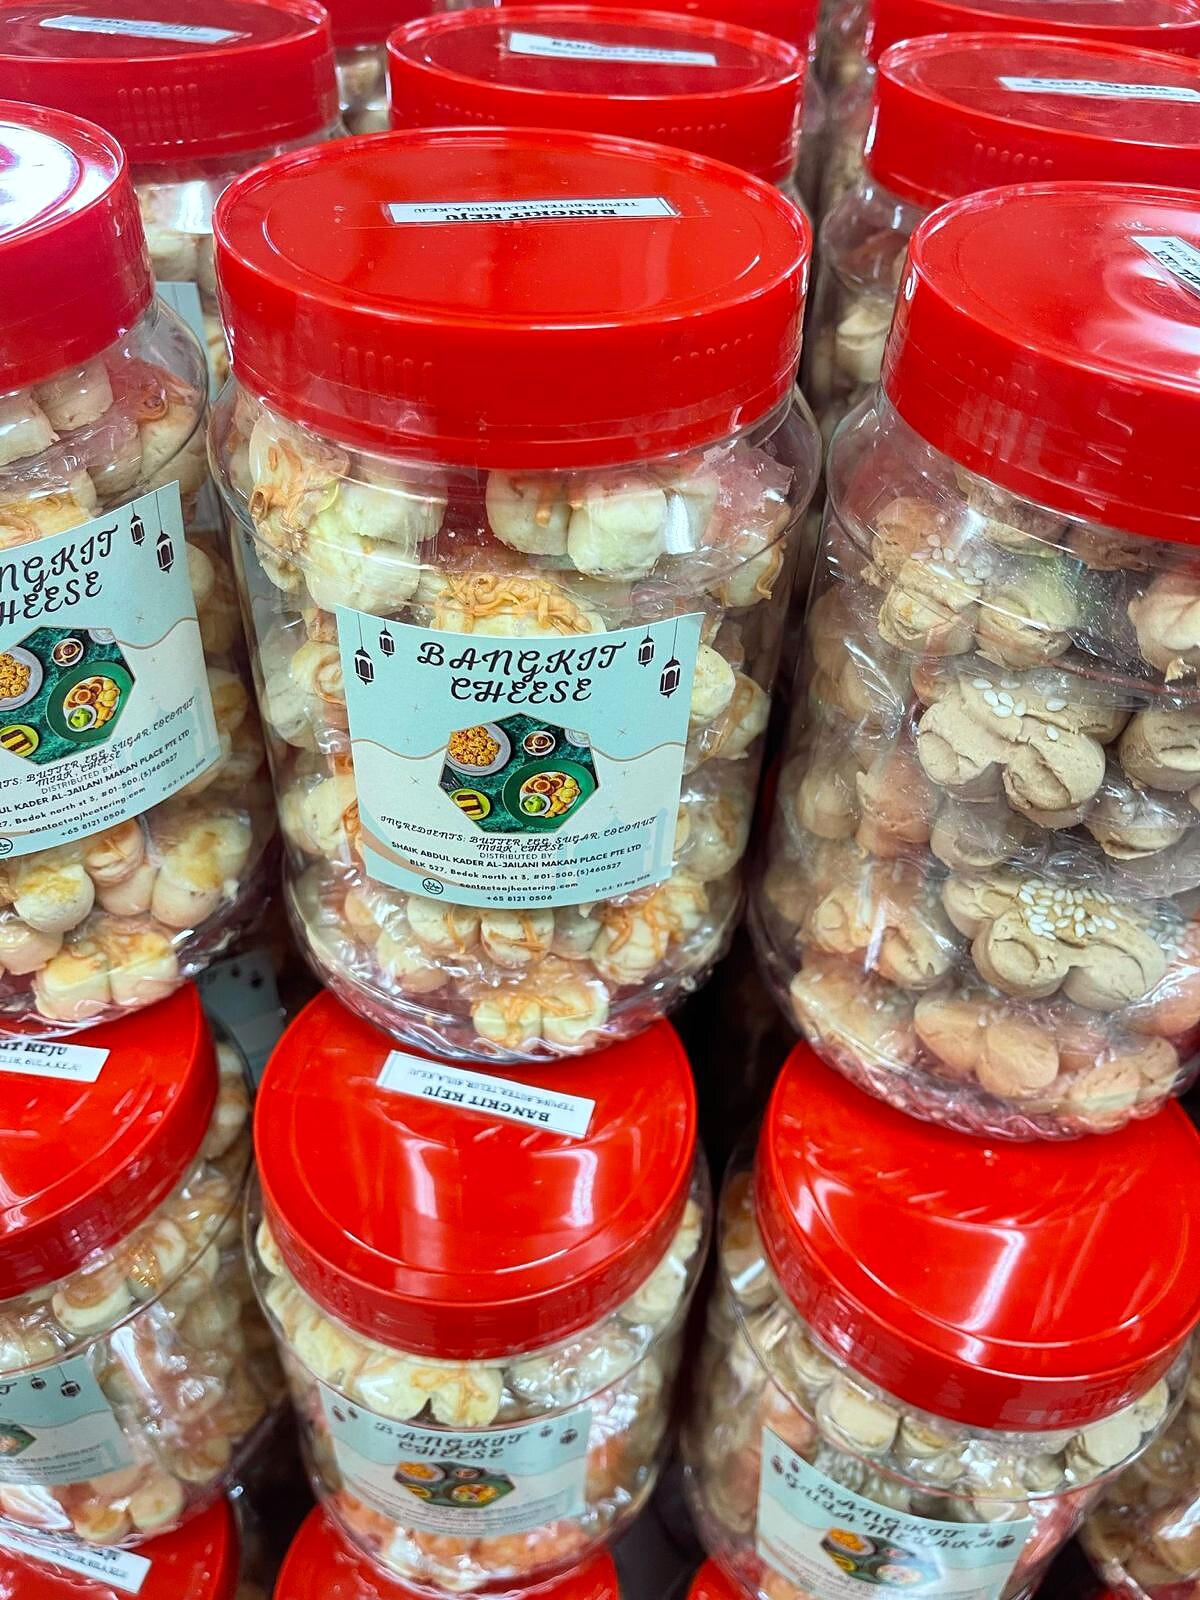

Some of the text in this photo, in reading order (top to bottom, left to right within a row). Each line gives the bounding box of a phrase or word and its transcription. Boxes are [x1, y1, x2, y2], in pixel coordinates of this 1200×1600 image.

[445, 209, 617, 221] BANGKIT KEJU
[417, 641, 627, 682] BANGKIT
[450, 677, 593, 704] CHEESE
[14, 797, 49, 811] KADER
[51, 778, 103, 802] AL-JAILANI
[105, 762, 138, 781] MAKAN
[140, 747, 163, 765] PLACE
[165, 738, 177, 751] PTE
[178, 729, 190, 741] LTD
[41, 770, 100, 795] DISTRIBUTED
[15, 811, 47, 824] Bedok
[50, 803, 76, 816] north
[61, 808, 126, 836] +65 8121 0506
[380, 815, 466, 842] INGREDIENTS:
[603, 815, 657, 837] COCONUT
[391, 841, 419, 855] SHAIK
[420, 850, 450, 862] ABDUL
[453, 856, 484, 867] KADER
[541, 857, 577, 868] MAKAN
[580, 851, 608, 863] PLACE
[610, 848, 625, 858] PTE
[627, 844, 641, 853] LTD
[480, 852, 538, 860] DISTRIBUTED
[409, 859, 426, 868] BLK
[450, 869, 479, 879] Bedok
[423, 1086, 551, 1122] BANGKIT KEJU
[374, 1422, 530, 1451] BANGKIT
